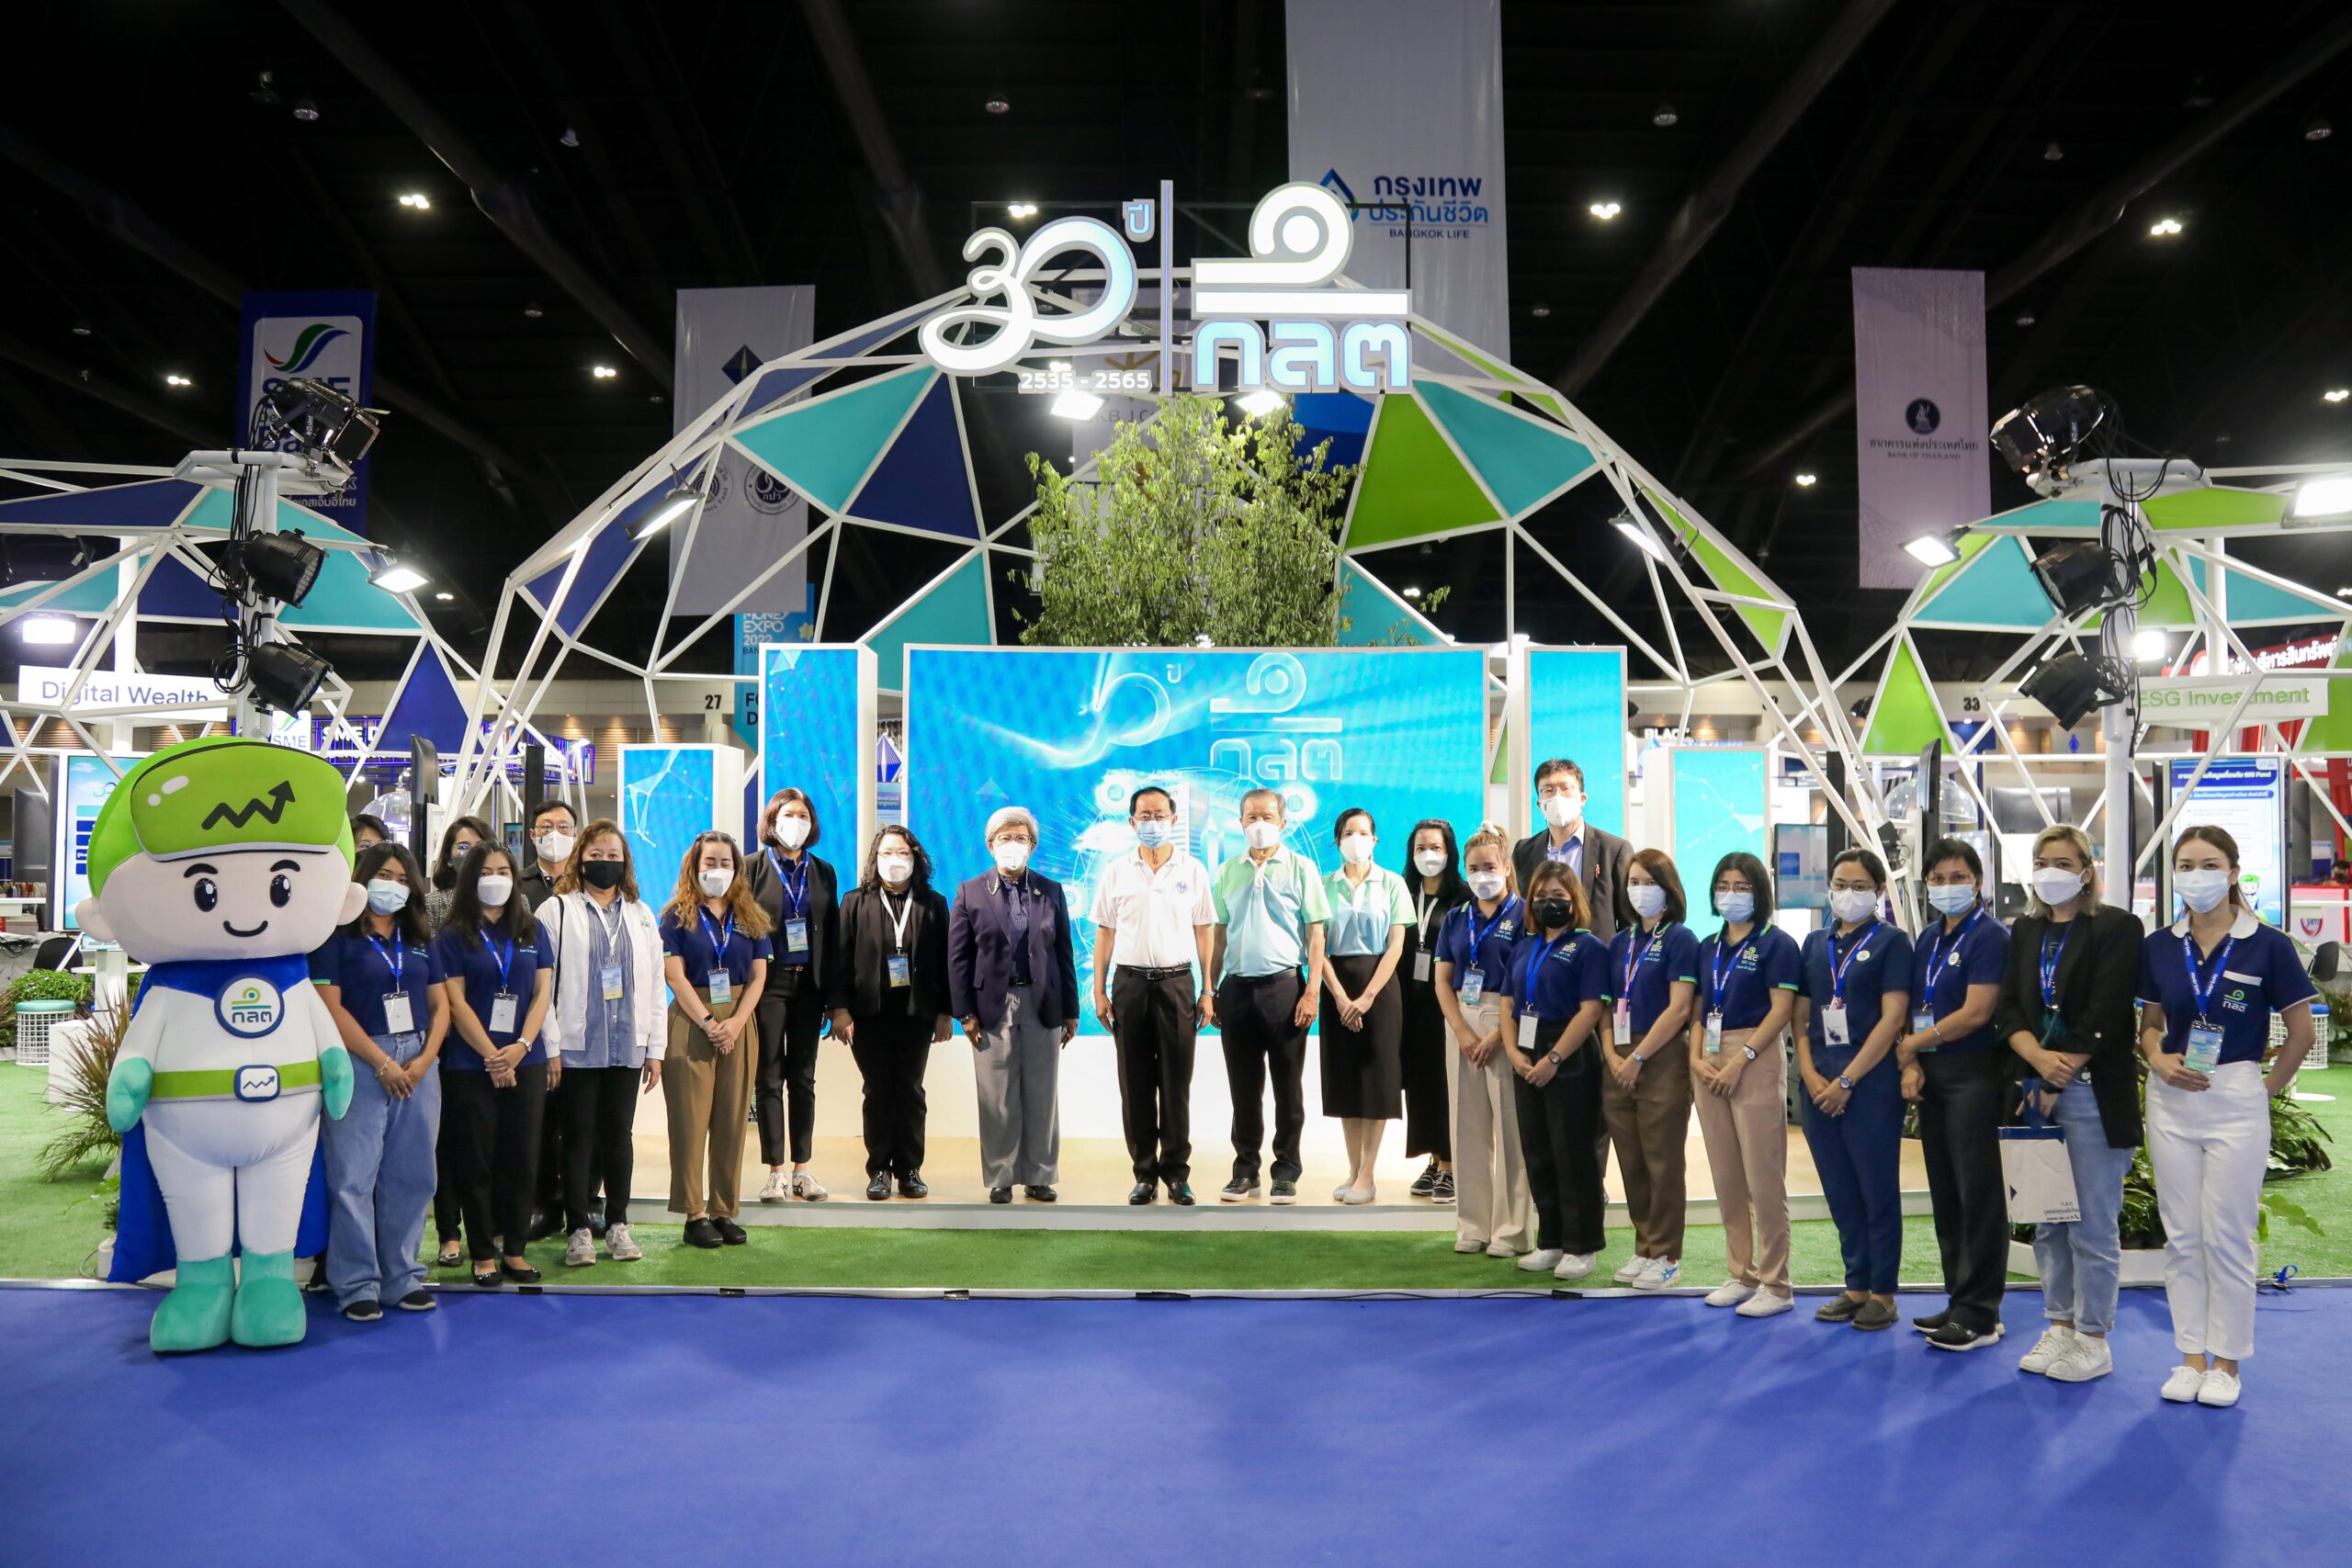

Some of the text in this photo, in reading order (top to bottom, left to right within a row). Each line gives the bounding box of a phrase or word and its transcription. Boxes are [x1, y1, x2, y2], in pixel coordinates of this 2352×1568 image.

[1374, 175, 1482, 204] กรุงเทพ
[1369, 197, 1488, 223] ประกันชีวิต
[1123, 198, 1155, 242] ปี
[1447, 230, 1470, 239] LIFE
[1193, 318, 1412, 393] กลต
[1019, 372, 1074, 390] 2535
[1094, 372, 1149, 389] 2565
[1870, 437, 1979, 451] ธนาคารแห่งประเทศไทย
[742, 620, 785, 634] EXPO
[742, 634, 773, 647] 2022
[42, 681, 209, 705] Digital Wealth
[2141, 687, 2311, 706] ESG Invesment
[705, 694, 722, 710] 27
[1963, 696, 1981, 711] 33
[1644, 727, 1690, 739] BLAC
[274, 734, 307, 748] SME
[232, 1010, 273, 1023] กลต
